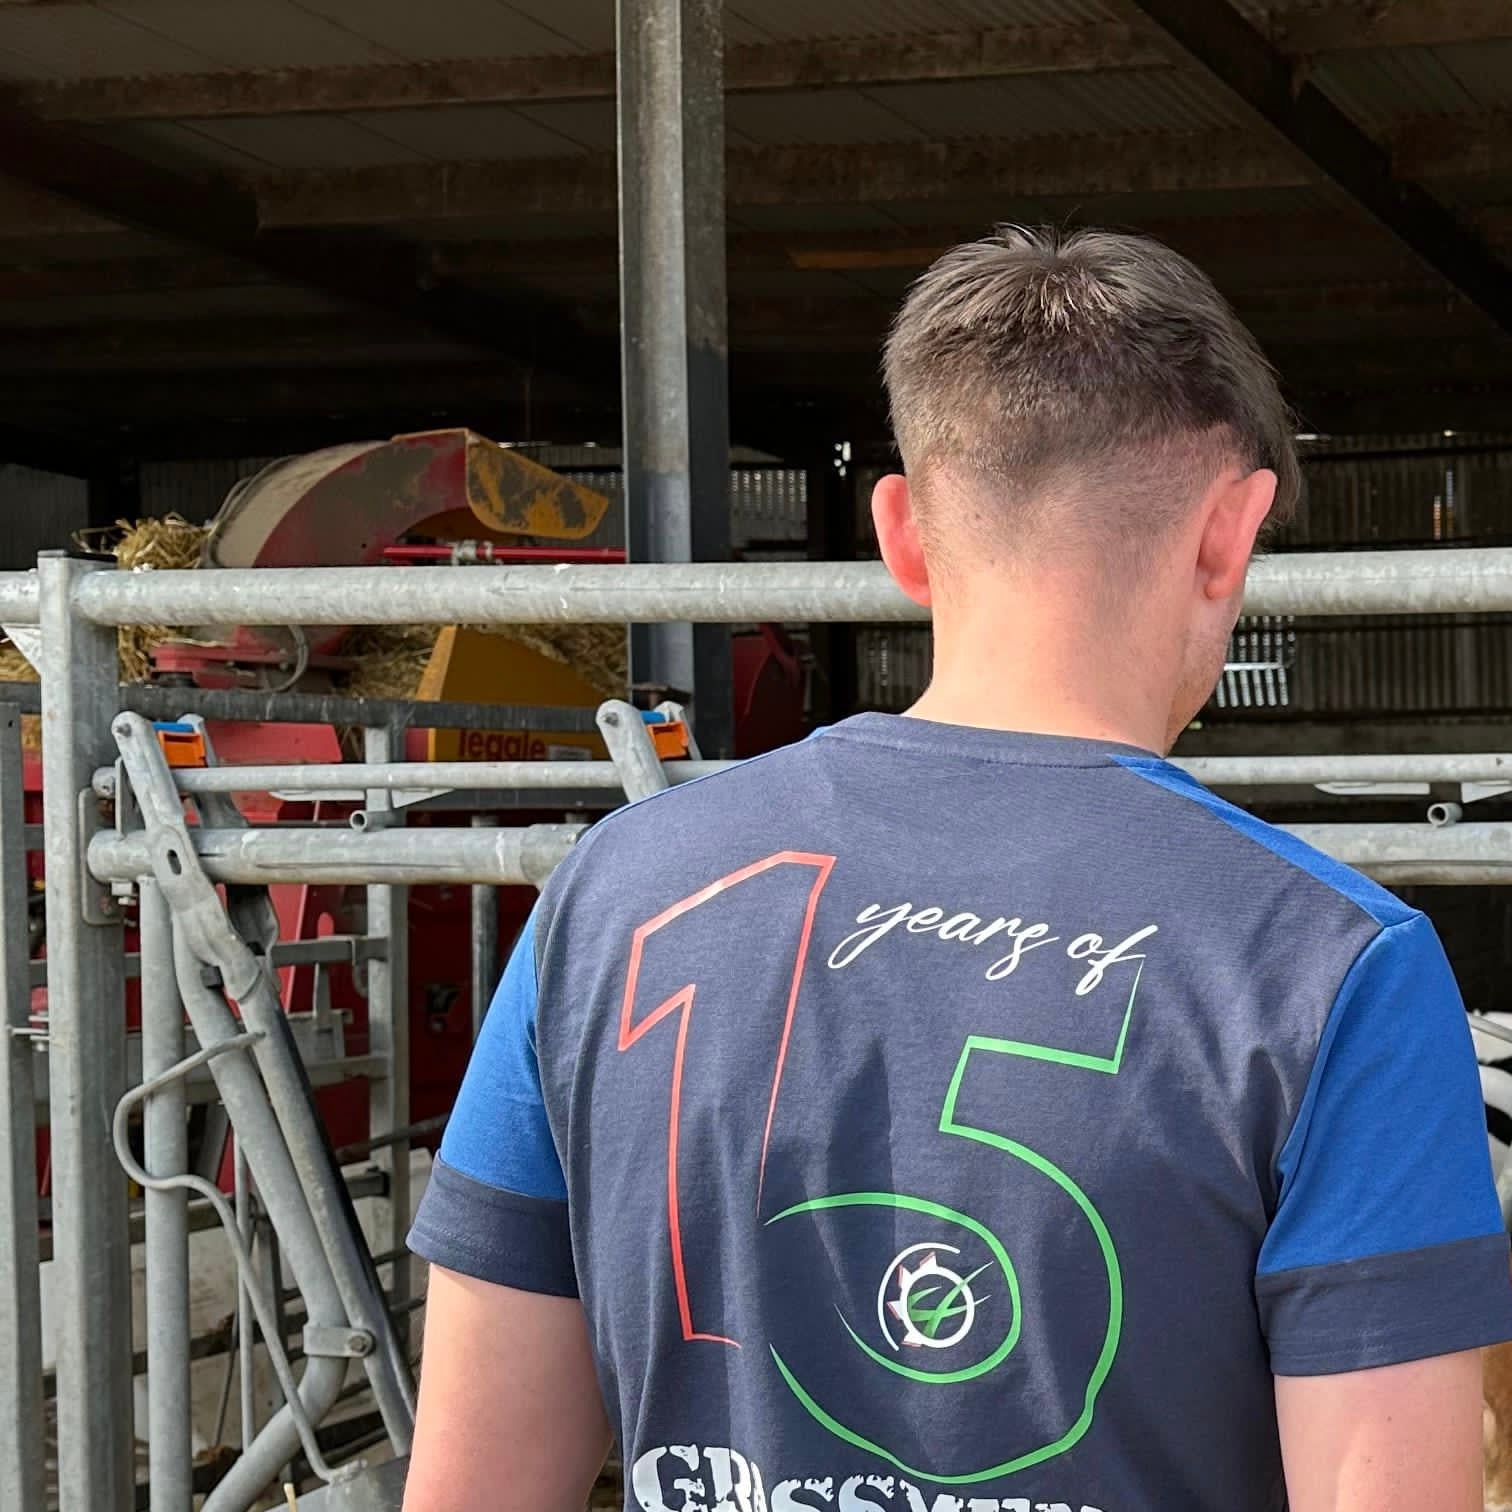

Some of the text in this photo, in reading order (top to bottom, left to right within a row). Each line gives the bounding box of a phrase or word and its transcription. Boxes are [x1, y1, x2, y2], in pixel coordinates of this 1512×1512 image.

[828, 902, 1158, 996] years of
[617, 850, 1144, 1483] 15
